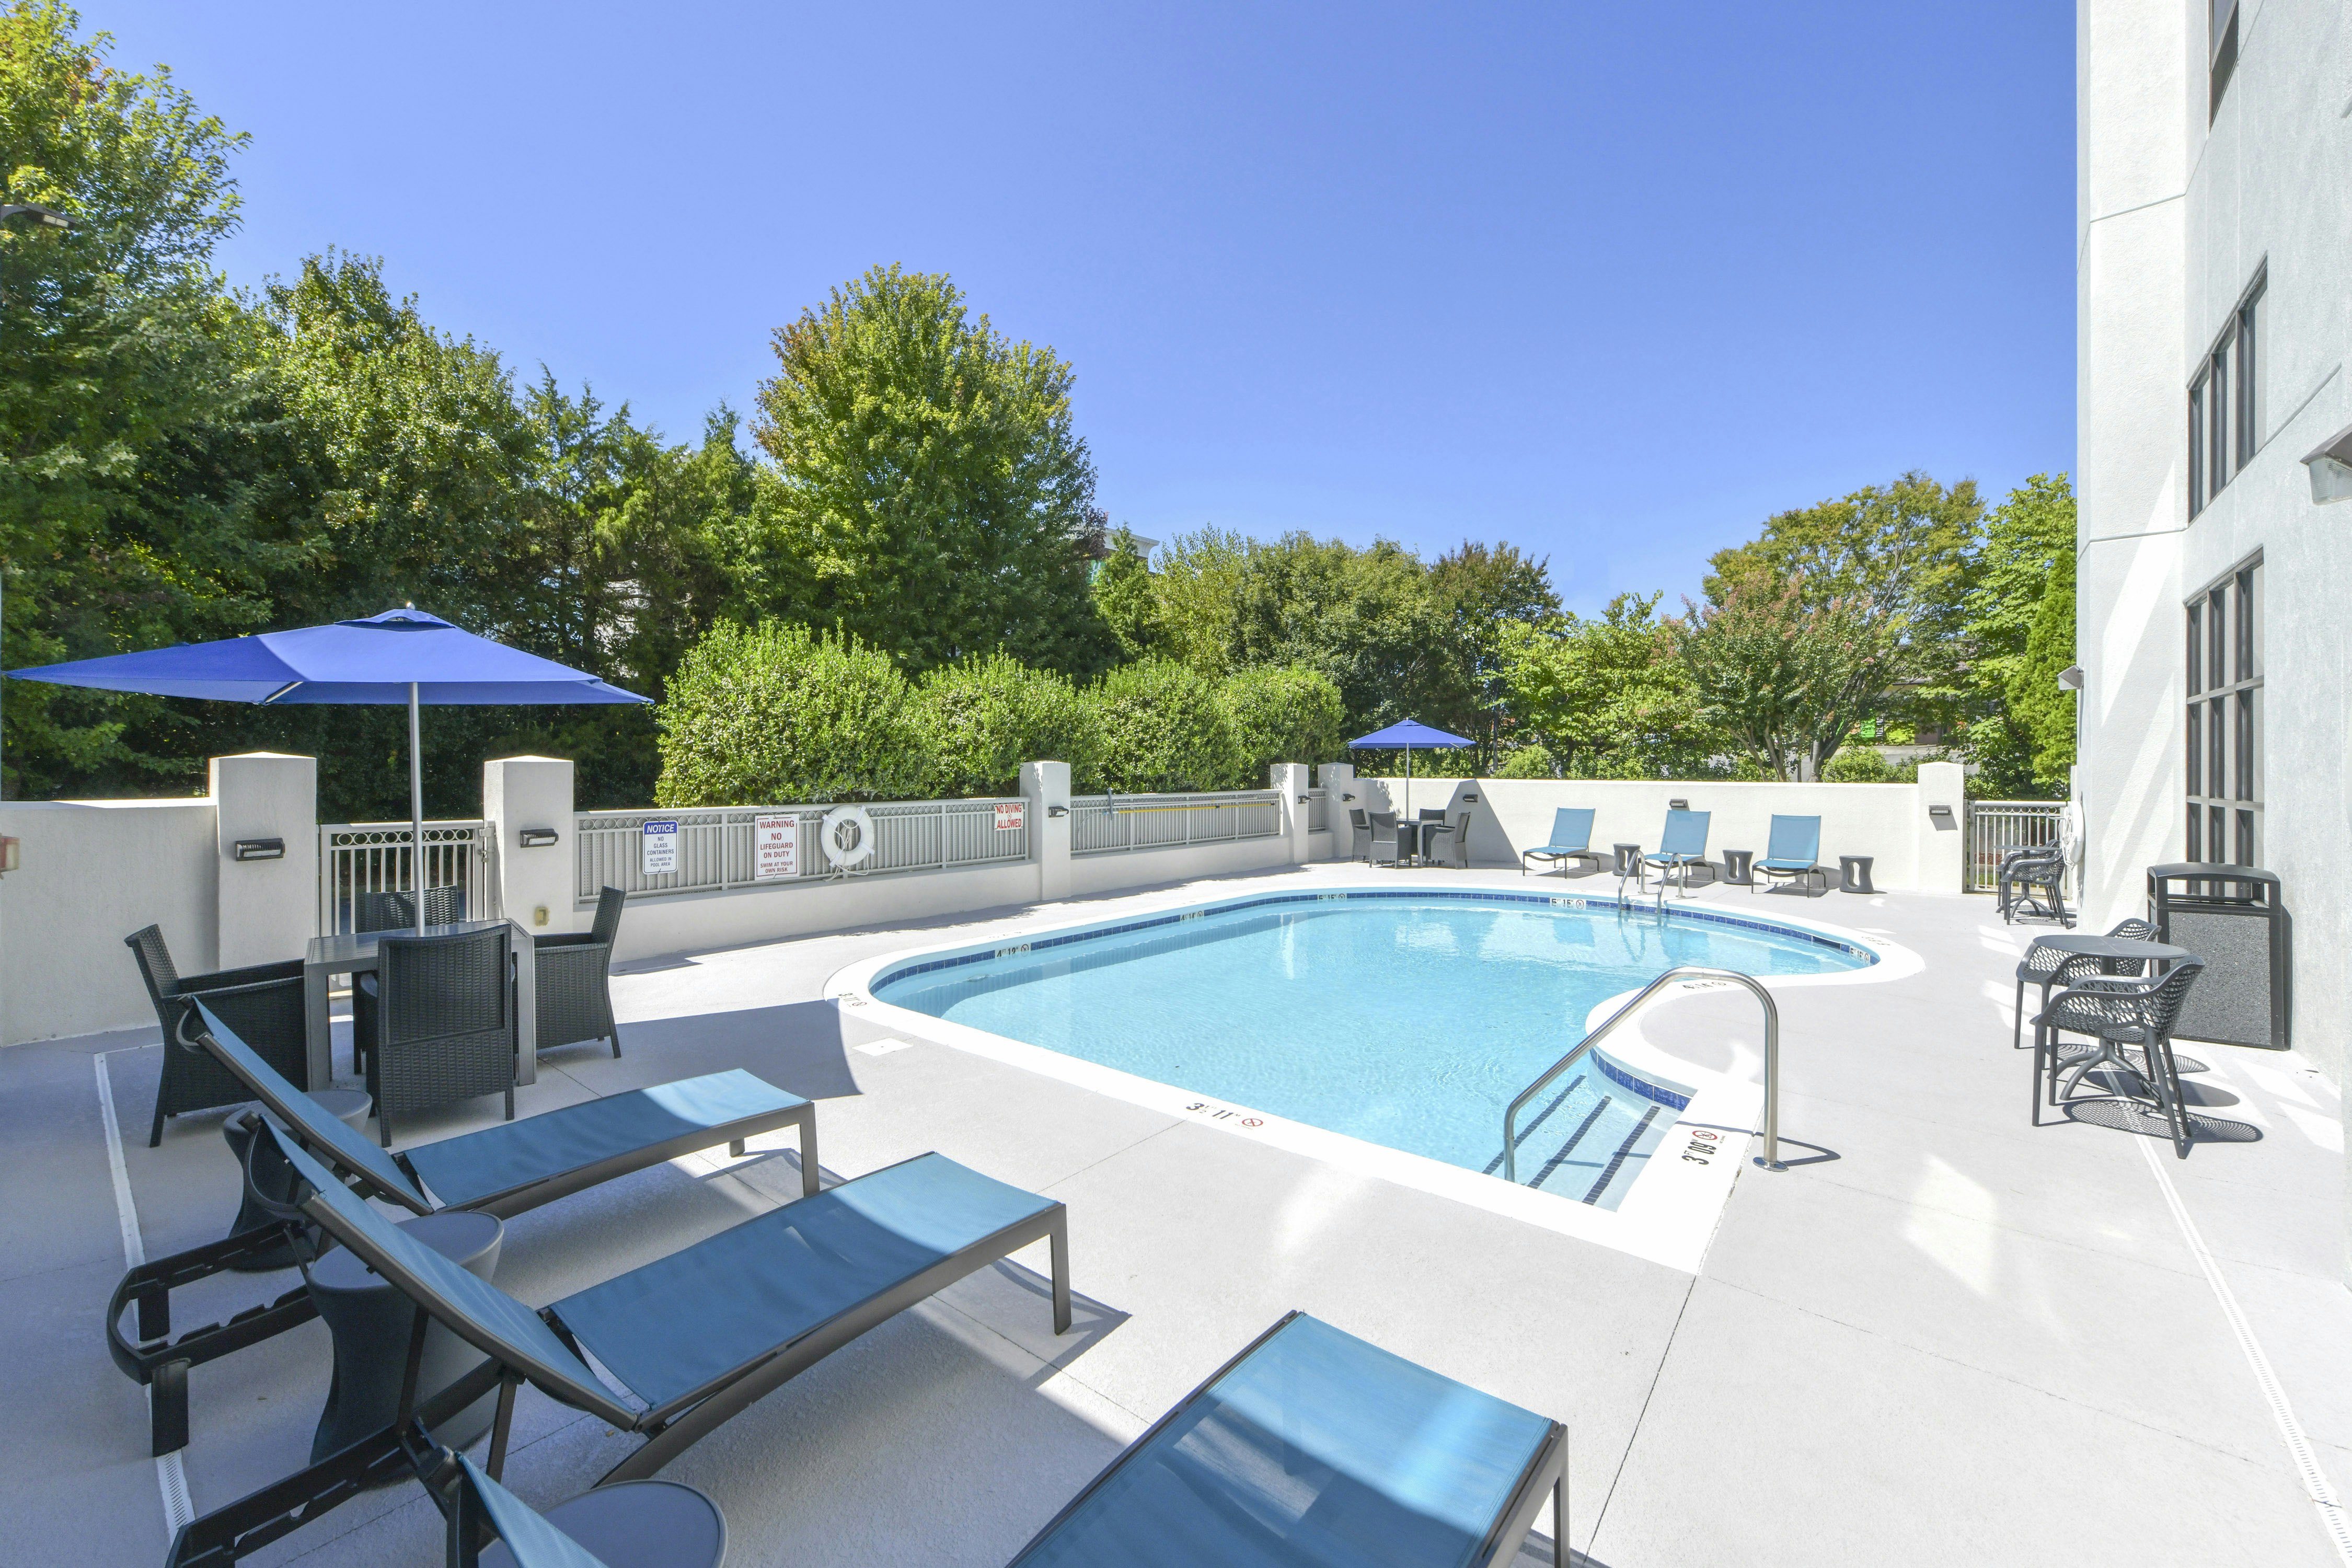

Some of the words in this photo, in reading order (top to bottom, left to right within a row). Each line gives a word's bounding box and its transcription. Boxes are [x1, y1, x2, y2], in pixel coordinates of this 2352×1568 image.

[996, 805, 1004, 814] NO
[1005, 804, 1022, 814] DIVING
[759, 820, 794, 829] WARNING
[997, 818, 1021, 829] ALLOWED
[647, 824, 675, 833] NOTICE
[771, 832, 782, 840] NO
[760, 842, 793, 850] LIFEGUARD
